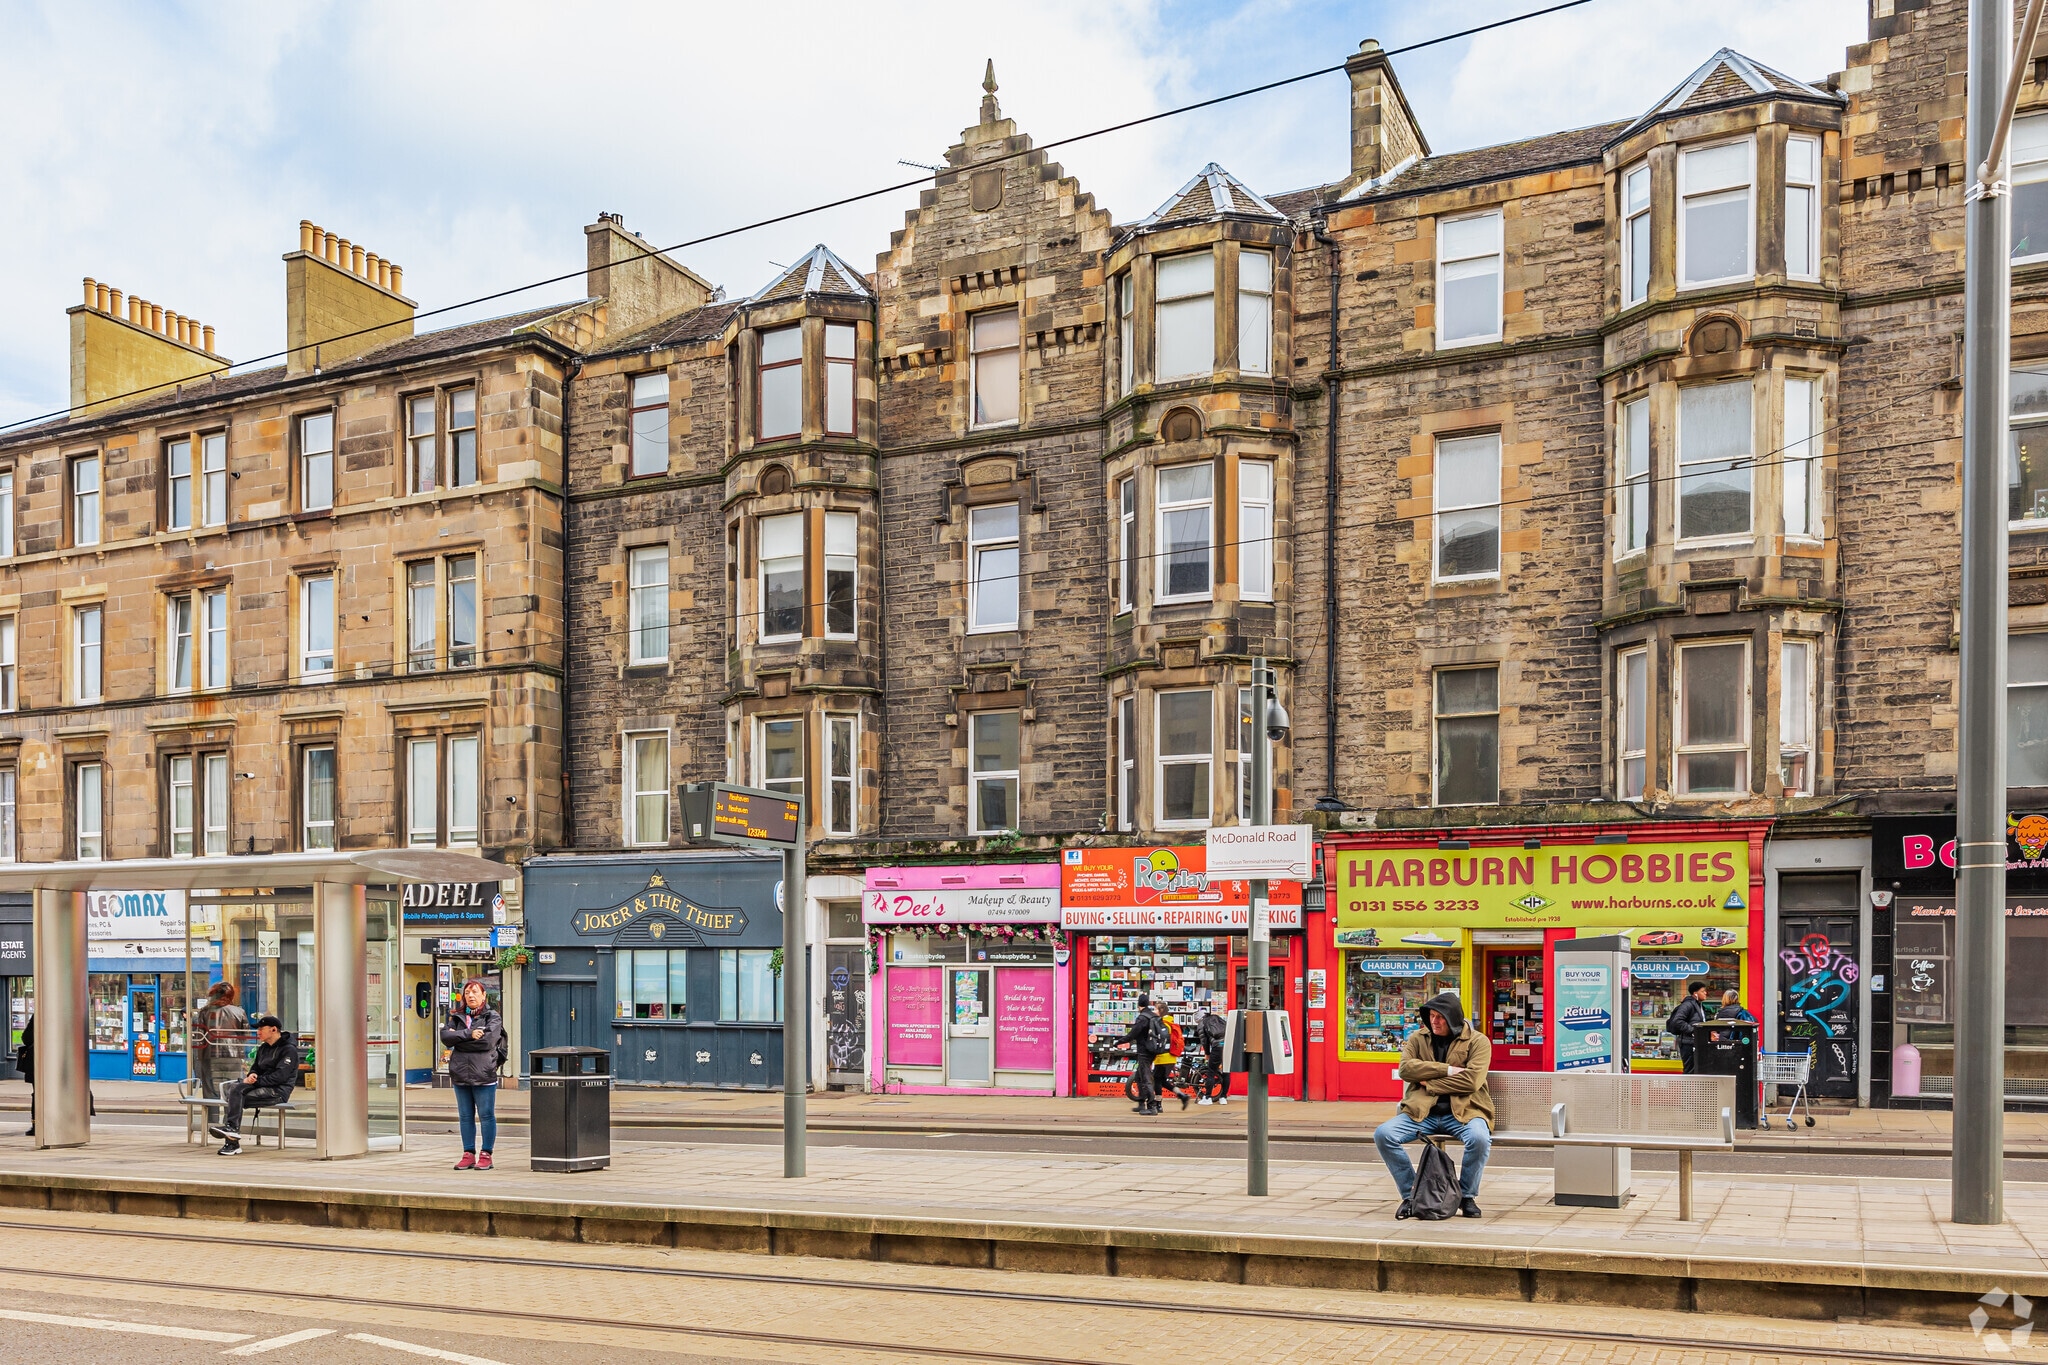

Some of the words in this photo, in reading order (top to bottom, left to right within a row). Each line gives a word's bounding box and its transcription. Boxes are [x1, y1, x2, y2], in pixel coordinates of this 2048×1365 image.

[1212, 832, 1265, 844] McDonald
[1268, 831, 1297, 842] Road
[1349, 857, 1534, 887] HARBURN
[1552, 852, 1736, 885] HOBBIES
[650, 876, 664, 887] The
[403, 883, 484, 907] ADEEL
[893, 895, 946, 917] Dee's
[968, 894, 1004, 906] Makeup
[1006, 894, 1016, 904] &
[1018, 894, 1052, 907] Beauty
[1350, 900, 1386, 912] 0131
[1392, 900, 1428, 911] 556
[1434, 900, 1480, 911] 3233
[1571, 894, 1716, 910] www.harburns.co.uk
[439, 912, 459, 920] Repairs
[466, 912, 484, 920] Spares
[583, 909, 633, 932] JOKER
[634, 898, 648, 913] &
[649, 893, 682, 914] THE
[686, 904, 734, 929] THIEF
[1007, 908, 1030, 916] 970009
[1065, 912, 1105, 925] BUYING
[1112, 912, 1156, 925] SELLING
[1164, 910, 1222, 924] REPAIRING
[845, 914, 858, 922] 70
[1, 941, 24, 949] ESTATE
[1, 950, 26, 959] AGENTS
[1911, 959, 1935, 971] Coffee
[1029, 995, 1045, 1004] Party
[1028, 1004, 1042, 1012] Nails
[1565, 1006, 1602, 1017] Return
[1024, 1015, 1049, 1024] Eyebrows
[999, 1025, 1018, 1034] Beauty
[1010, 1035, 1038, 1044] Threading
[138, 1043, 151, 1054] ria
[1562, 1046, 1603, 1057] contactless
